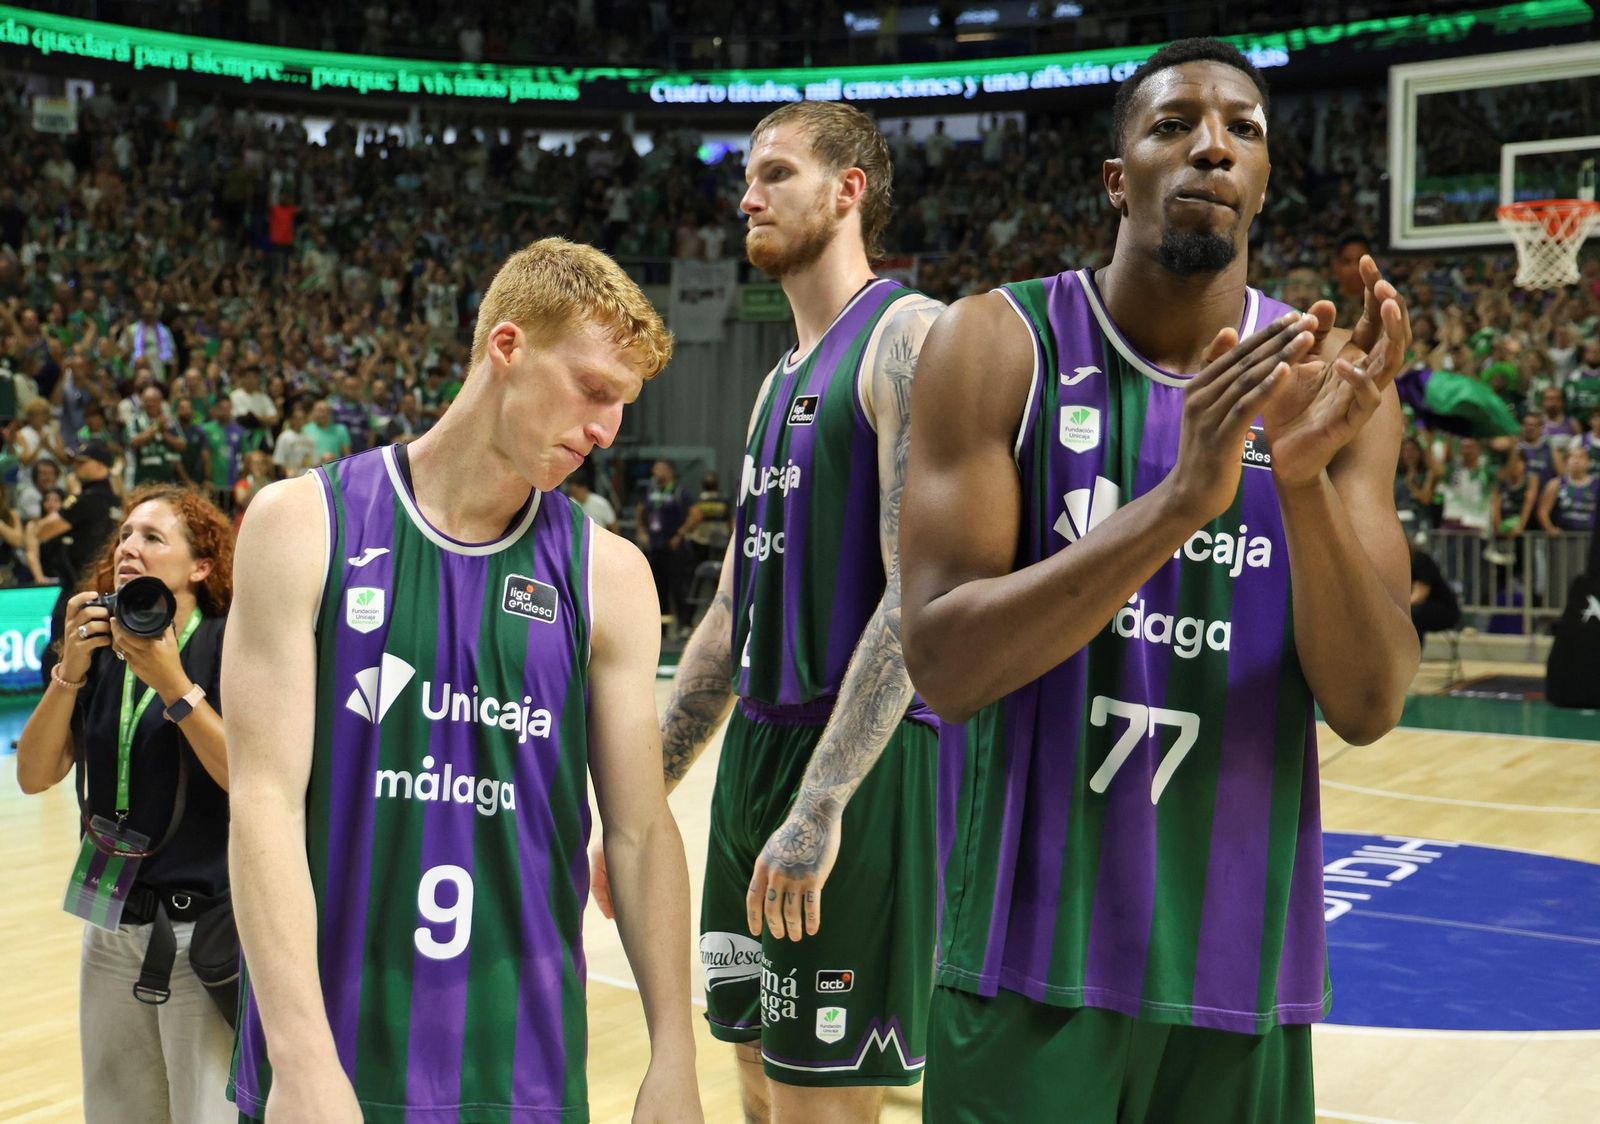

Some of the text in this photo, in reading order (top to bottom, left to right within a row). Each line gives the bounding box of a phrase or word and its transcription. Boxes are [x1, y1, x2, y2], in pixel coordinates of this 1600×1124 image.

[31, 28, 131, 62] quedará
[134, 46, 189, 70] para
[311, 66, 396, 95] porque
[398, 69, 419, 92] la
[650, 81, 727, 103] Cuatro
[804, 78, 842, 101] mil
[843, 76, 963, 100] emociones
[963, 75, 978, 100] y
[983, 71, 1030, 93] una
[1030, 61, 1110, 90] afición
[1242, 449, 1271, 464] des
[1173, 524, 1272, 578] caja
[508, 599, 552, 618] endesa
[510, 586, 531, 601] liga
[1111, 592, 1231, 659] álaga
[421, 681, 552, 744] Unicaja
[1089, 695, 1200, 805] 77
[414, 864, 474, 960] 9
[700, 936, 762, 968] madesa
[820, 979, 845, 989] acb
[761, 989, 798, 1022] aga
